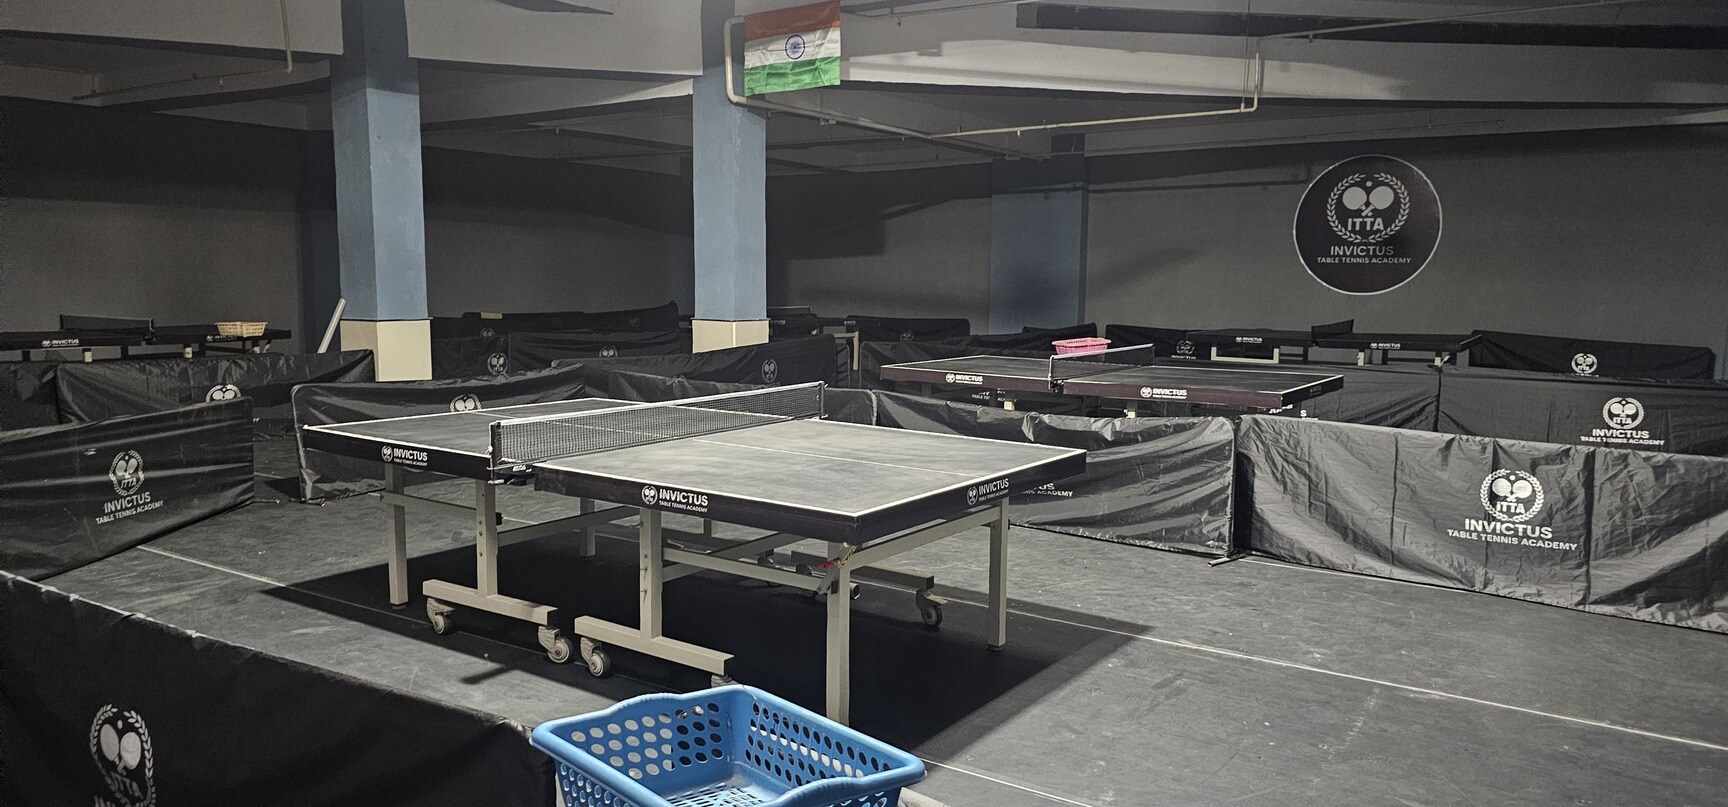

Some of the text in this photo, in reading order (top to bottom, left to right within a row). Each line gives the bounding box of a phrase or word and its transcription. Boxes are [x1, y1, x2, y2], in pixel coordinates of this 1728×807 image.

[1347, 217, 1385, 231] ITTA
[1330, 246, 1394, 256] INVICTUS
[955, 374, 983, 382] INVICTUS
[1152, 388, 1188, 396] INVICTUS
[1592, 428, 1650, 439] INVICTUS
[1628, 438, 1665, 446] ACADEMY
[393, 448, 428, 461] INVICTUS
[978, 478, 1010, 495] INVICTUS
[104, 491, 151, 513] INVICTUS
[659, 488, 709, 506] INVICTUS
[95, 500, 164, 525] TABLE TENNIS ACADEMY
[1496, 501, 1526, 514] ITTA
[1464, 518, 1553, 539] INVICTUS
[1447, 529, 1578, 551] TABLE TENNIS ACADEMY
